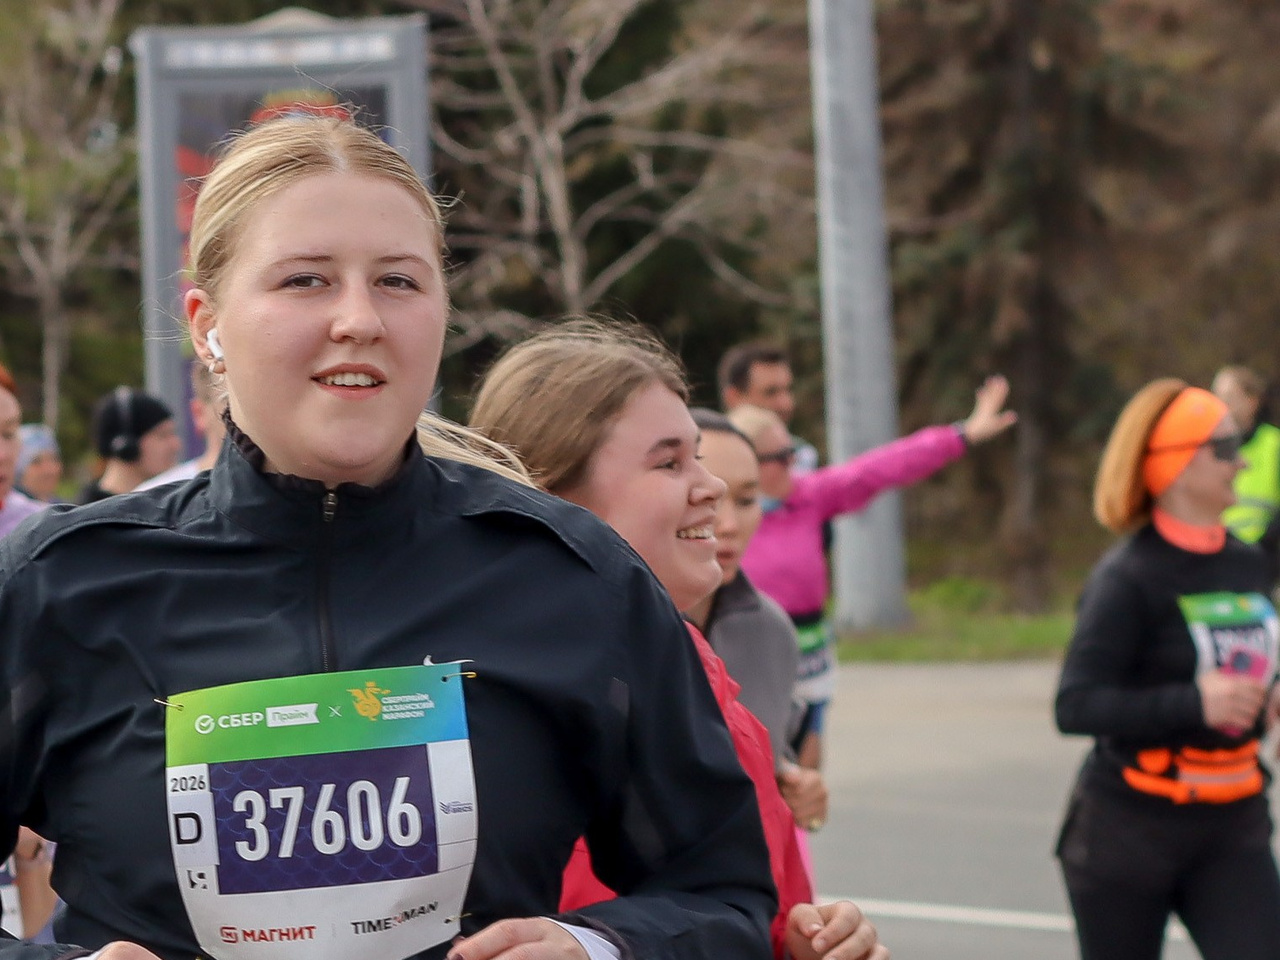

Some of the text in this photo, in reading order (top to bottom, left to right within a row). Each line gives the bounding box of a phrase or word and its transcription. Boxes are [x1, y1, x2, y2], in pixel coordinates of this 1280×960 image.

[217, 711, 265, 729] СБЕР
[170, 776, 206, 792] 2026
[172, 812, 203, 845] D
[232, 776, 423, 863] 37606
[241, 925, 318, 944] МАГНИТ
